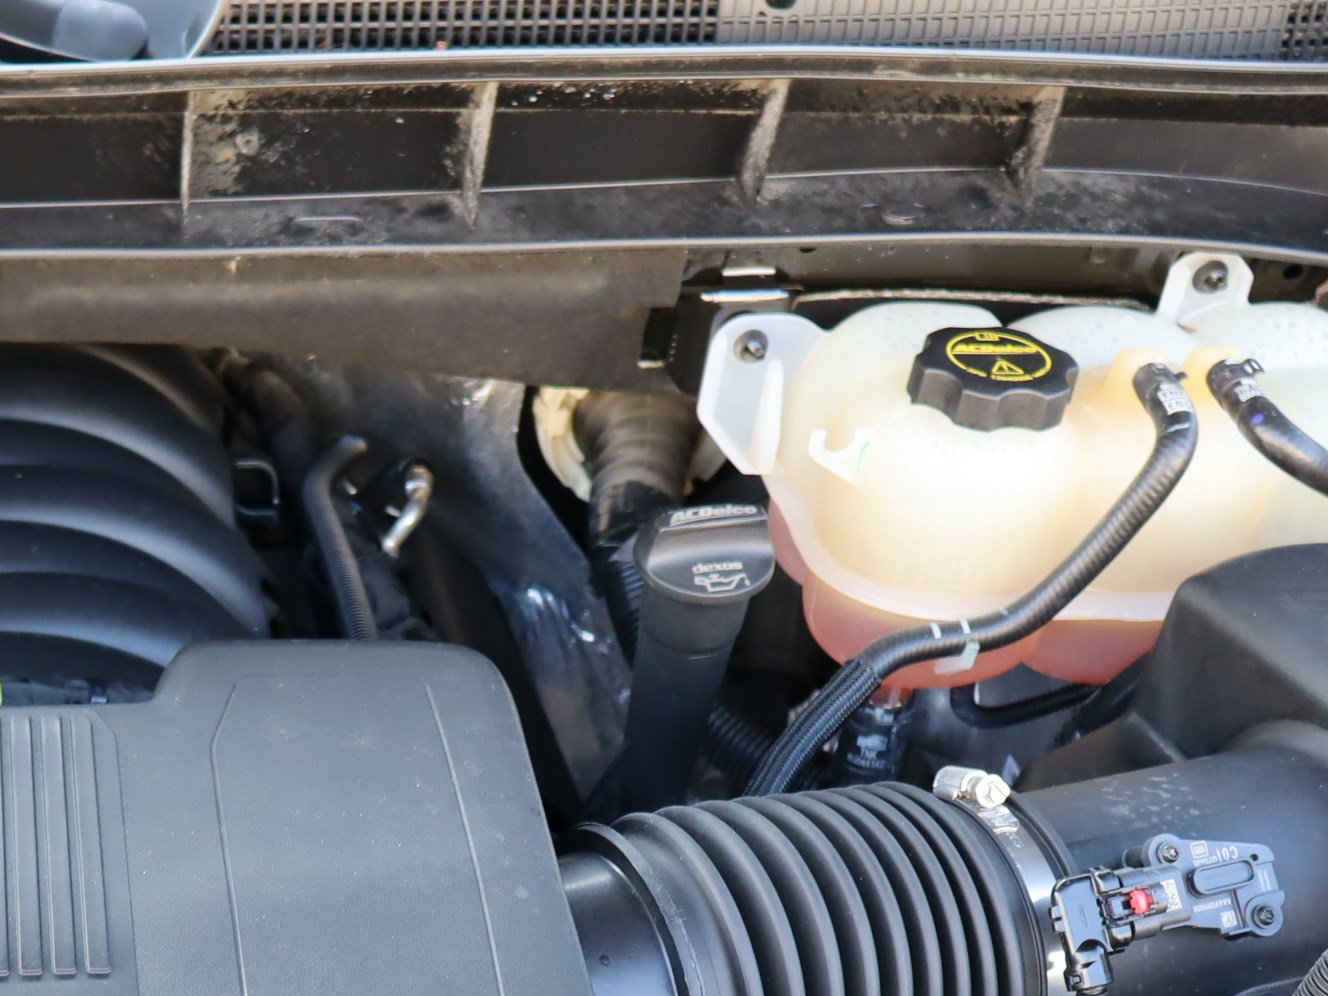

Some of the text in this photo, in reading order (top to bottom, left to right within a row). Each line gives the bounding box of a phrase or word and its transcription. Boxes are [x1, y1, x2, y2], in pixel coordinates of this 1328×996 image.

[671, 503, 758, 524] ACDelco
[692, 561, 744, 575] dexos
[1216, 845, 1239, 863] C01
